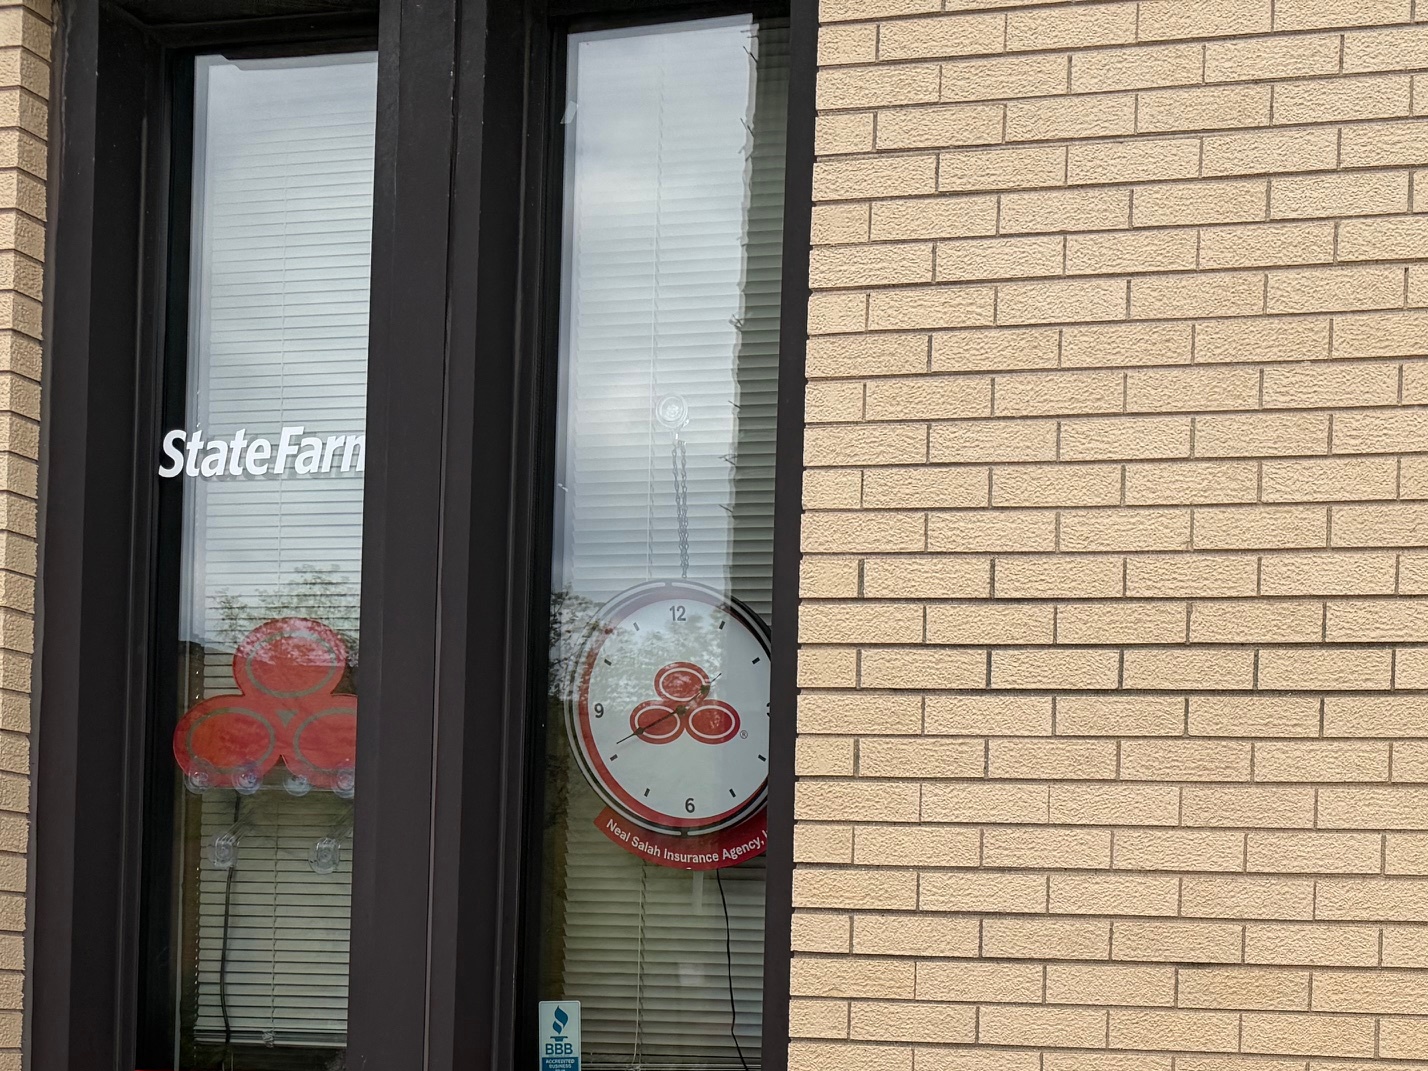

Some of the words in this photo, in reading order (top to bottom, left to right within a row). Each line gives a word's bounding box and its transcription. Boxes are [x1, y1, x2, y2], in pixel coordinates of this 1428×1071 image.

[669, 605, 686, 622] 12
[594, 702, 604, 719] 9
[685, 798, 695, 813] 6
[606, 818, 631, 842] Neal
[632, 836, 660, 856] Salah
[663, 848, 719, 864] Insurance
[722, 836, 765, 860] Agency,
[545, 1043, 573, 1055] BBB
